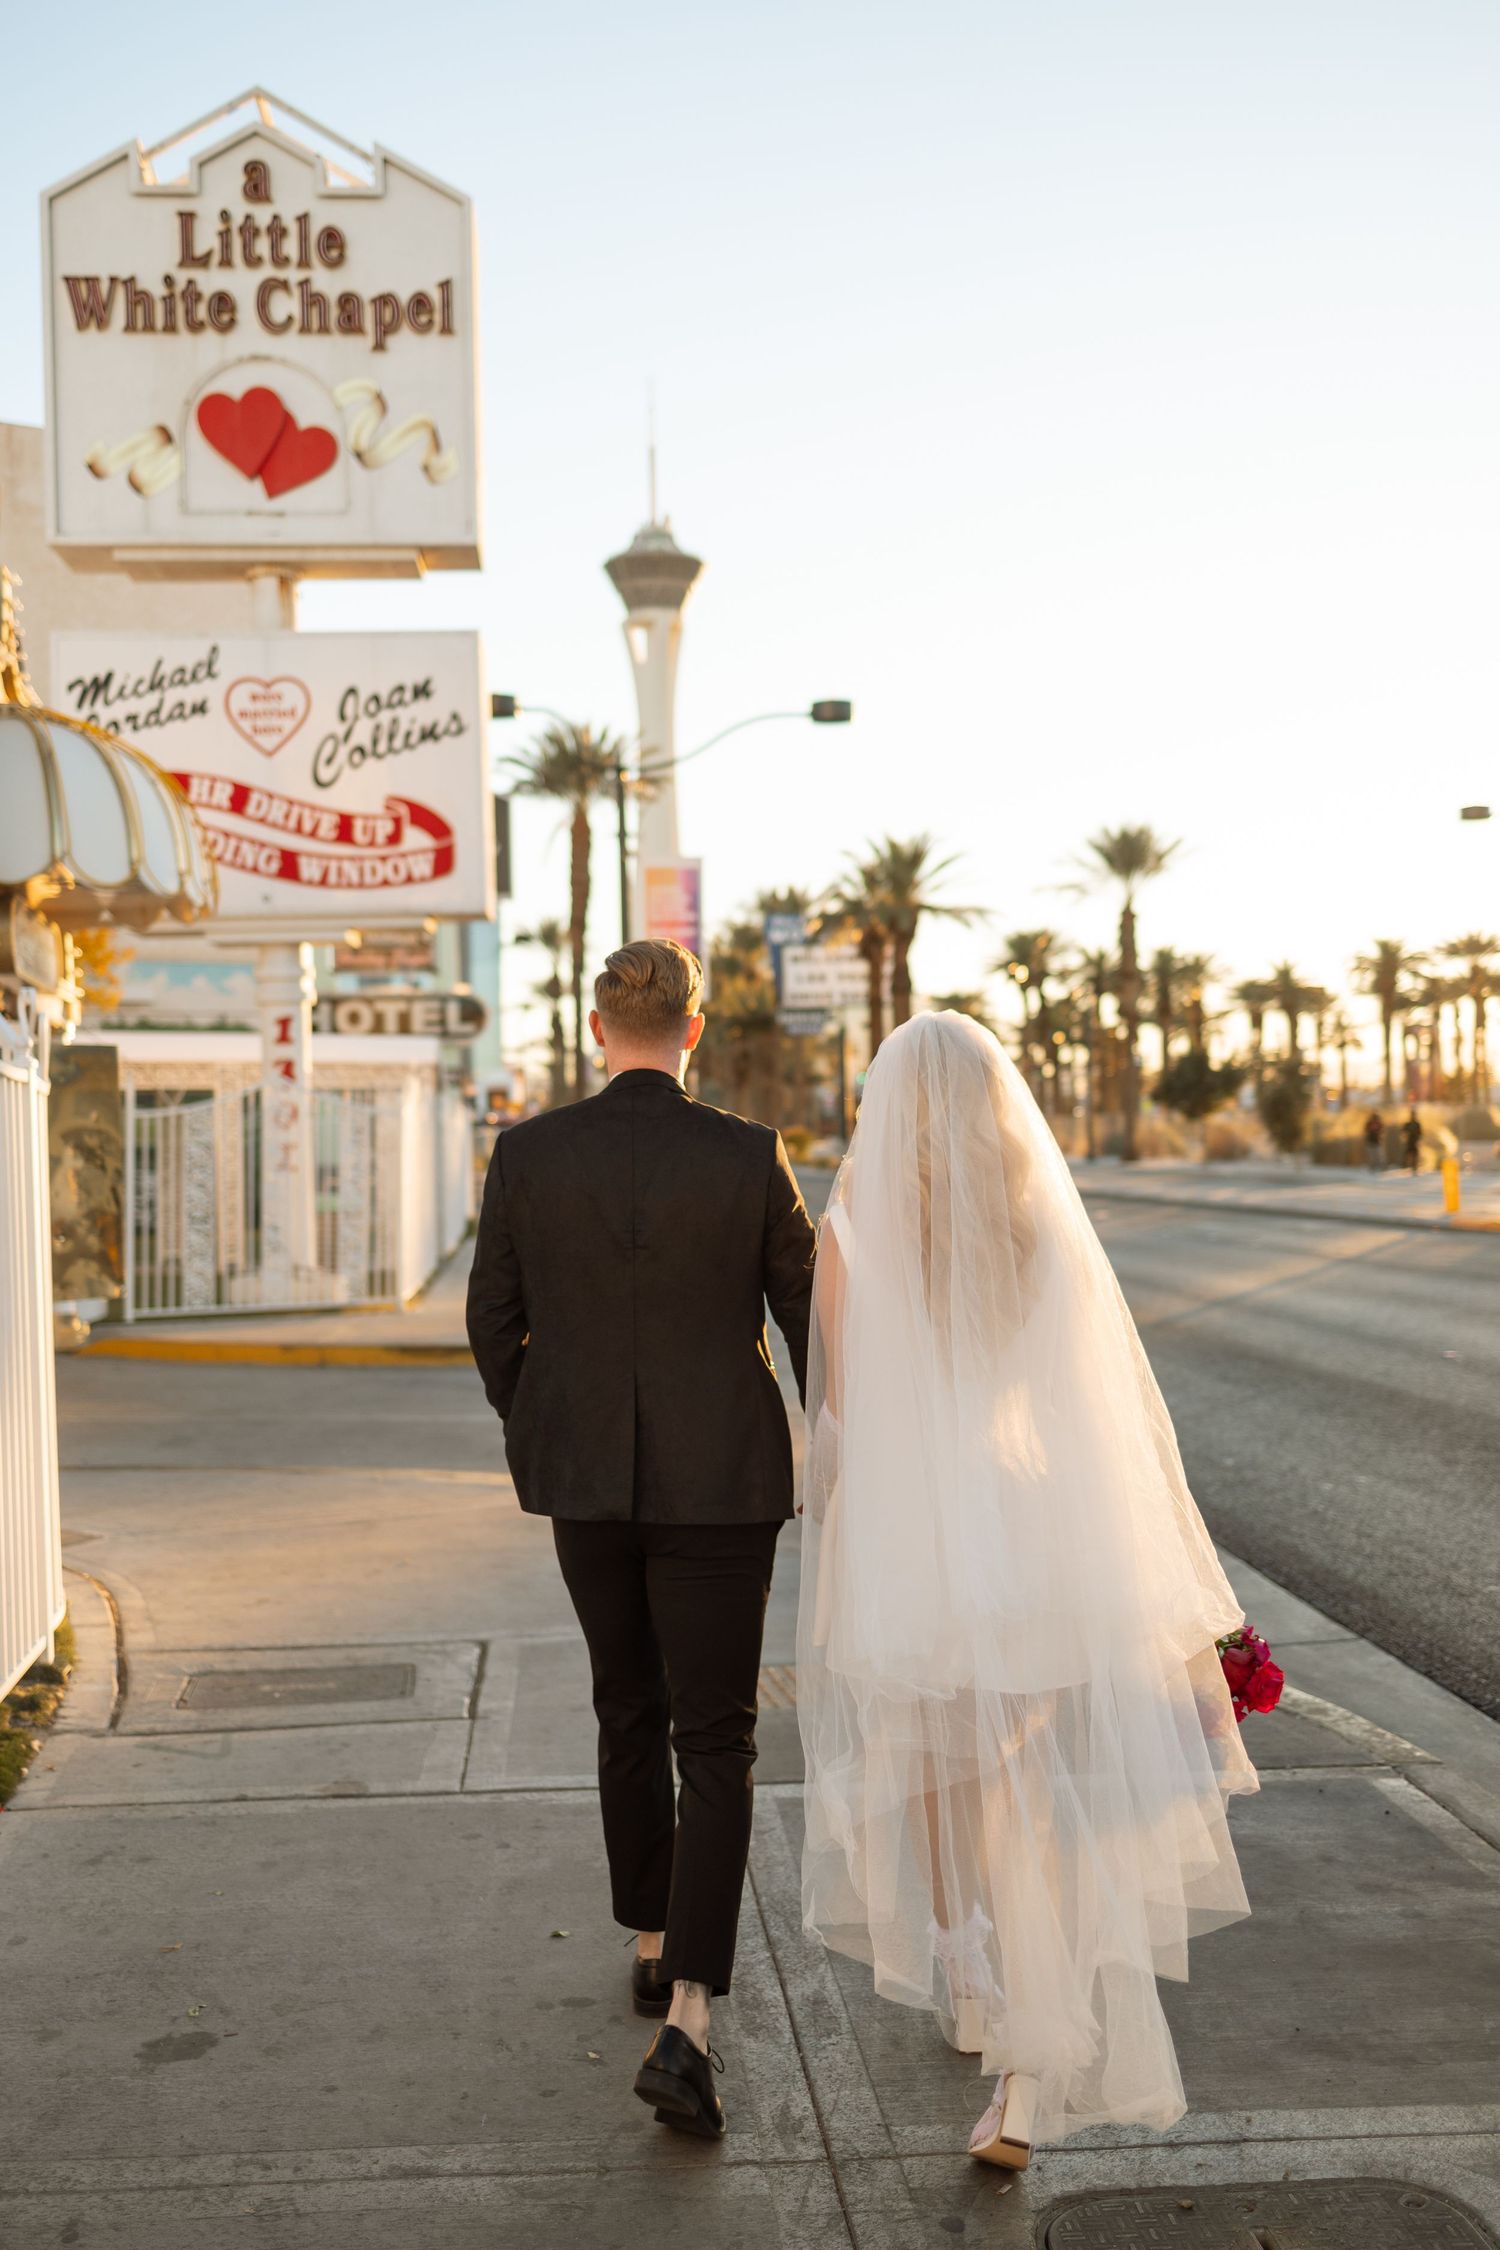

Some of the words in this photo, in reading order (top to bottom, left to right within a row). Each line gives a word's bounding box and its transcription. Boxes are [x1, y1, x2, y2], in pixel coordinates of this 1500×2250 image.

[243, 160, 271, 202] a
[177, 209, 345, 269] Little
[63, 274, 237, 333] White
[256, 276, 455, 351] Chapel
[67, 644, 220, 710] Michael
[339, 676, 432, 744] Joan
[86, 696, 208, 735] ordan
[312, 710, 465, 788] Collins
[189, 776, 234, 809] HR
[244, 789, 341, 840] DRIVE
[352, 816, 396, 846] UP
[296, 851, 435, 885] WINDOW
